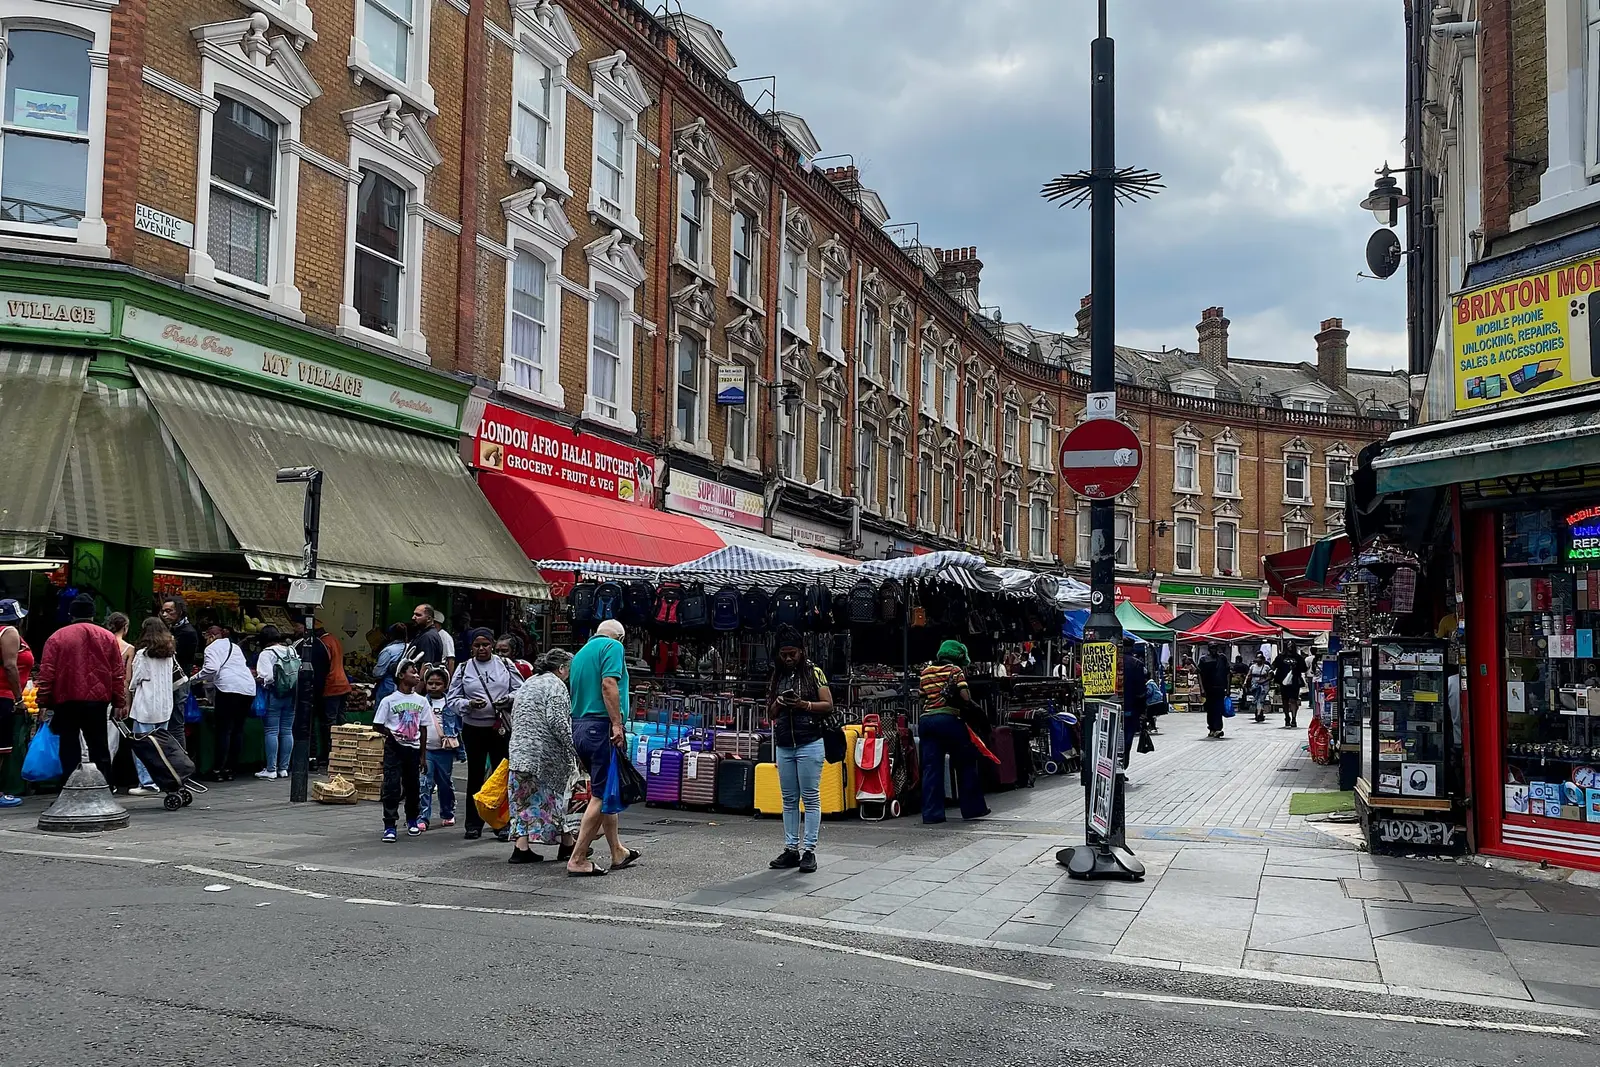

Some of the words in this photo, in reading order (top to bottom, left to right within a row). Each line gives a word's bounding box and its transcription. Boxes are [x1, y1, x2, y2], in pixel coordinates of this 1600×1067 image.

[136, 205, 181, 230] ELECTRIC
[136, 218, 176, 239] AVENUE
[8, 300, 96, 324] VILLAGE
[1458, 274, 1550, 325] BRIXTON
[1462, 333, 1516, 356] UNLOCKING,
[1518, 321, 1561, 342] REPAIRS,
[1475, 317, 1510, 336] MOBILE
[1511, 308, 1544, 328] PHONE
[1460, 354, 1489, 372] SALES
[1490, 352, 1497, 365] &
[1498, 336, 1565, 363] ACCESSORIES
[262, 351, 293, 377] MY
[298, 362, 364, 397] VILLAGE
[480, 418, 529, 451] LONDON
[531, 433, 560, 459] AFRO
[561, 442, 593, 468] HALAL
[594, 452, 635, 480] BUTCHER
[507, 453, 554, 477] GROCERY
[561, 468, 588, 486] FRUIT
[589, 474, 596, 488] &
[598, 477, 615, 492] VEG
[697, 480, 737, 508] SUPERMALT
